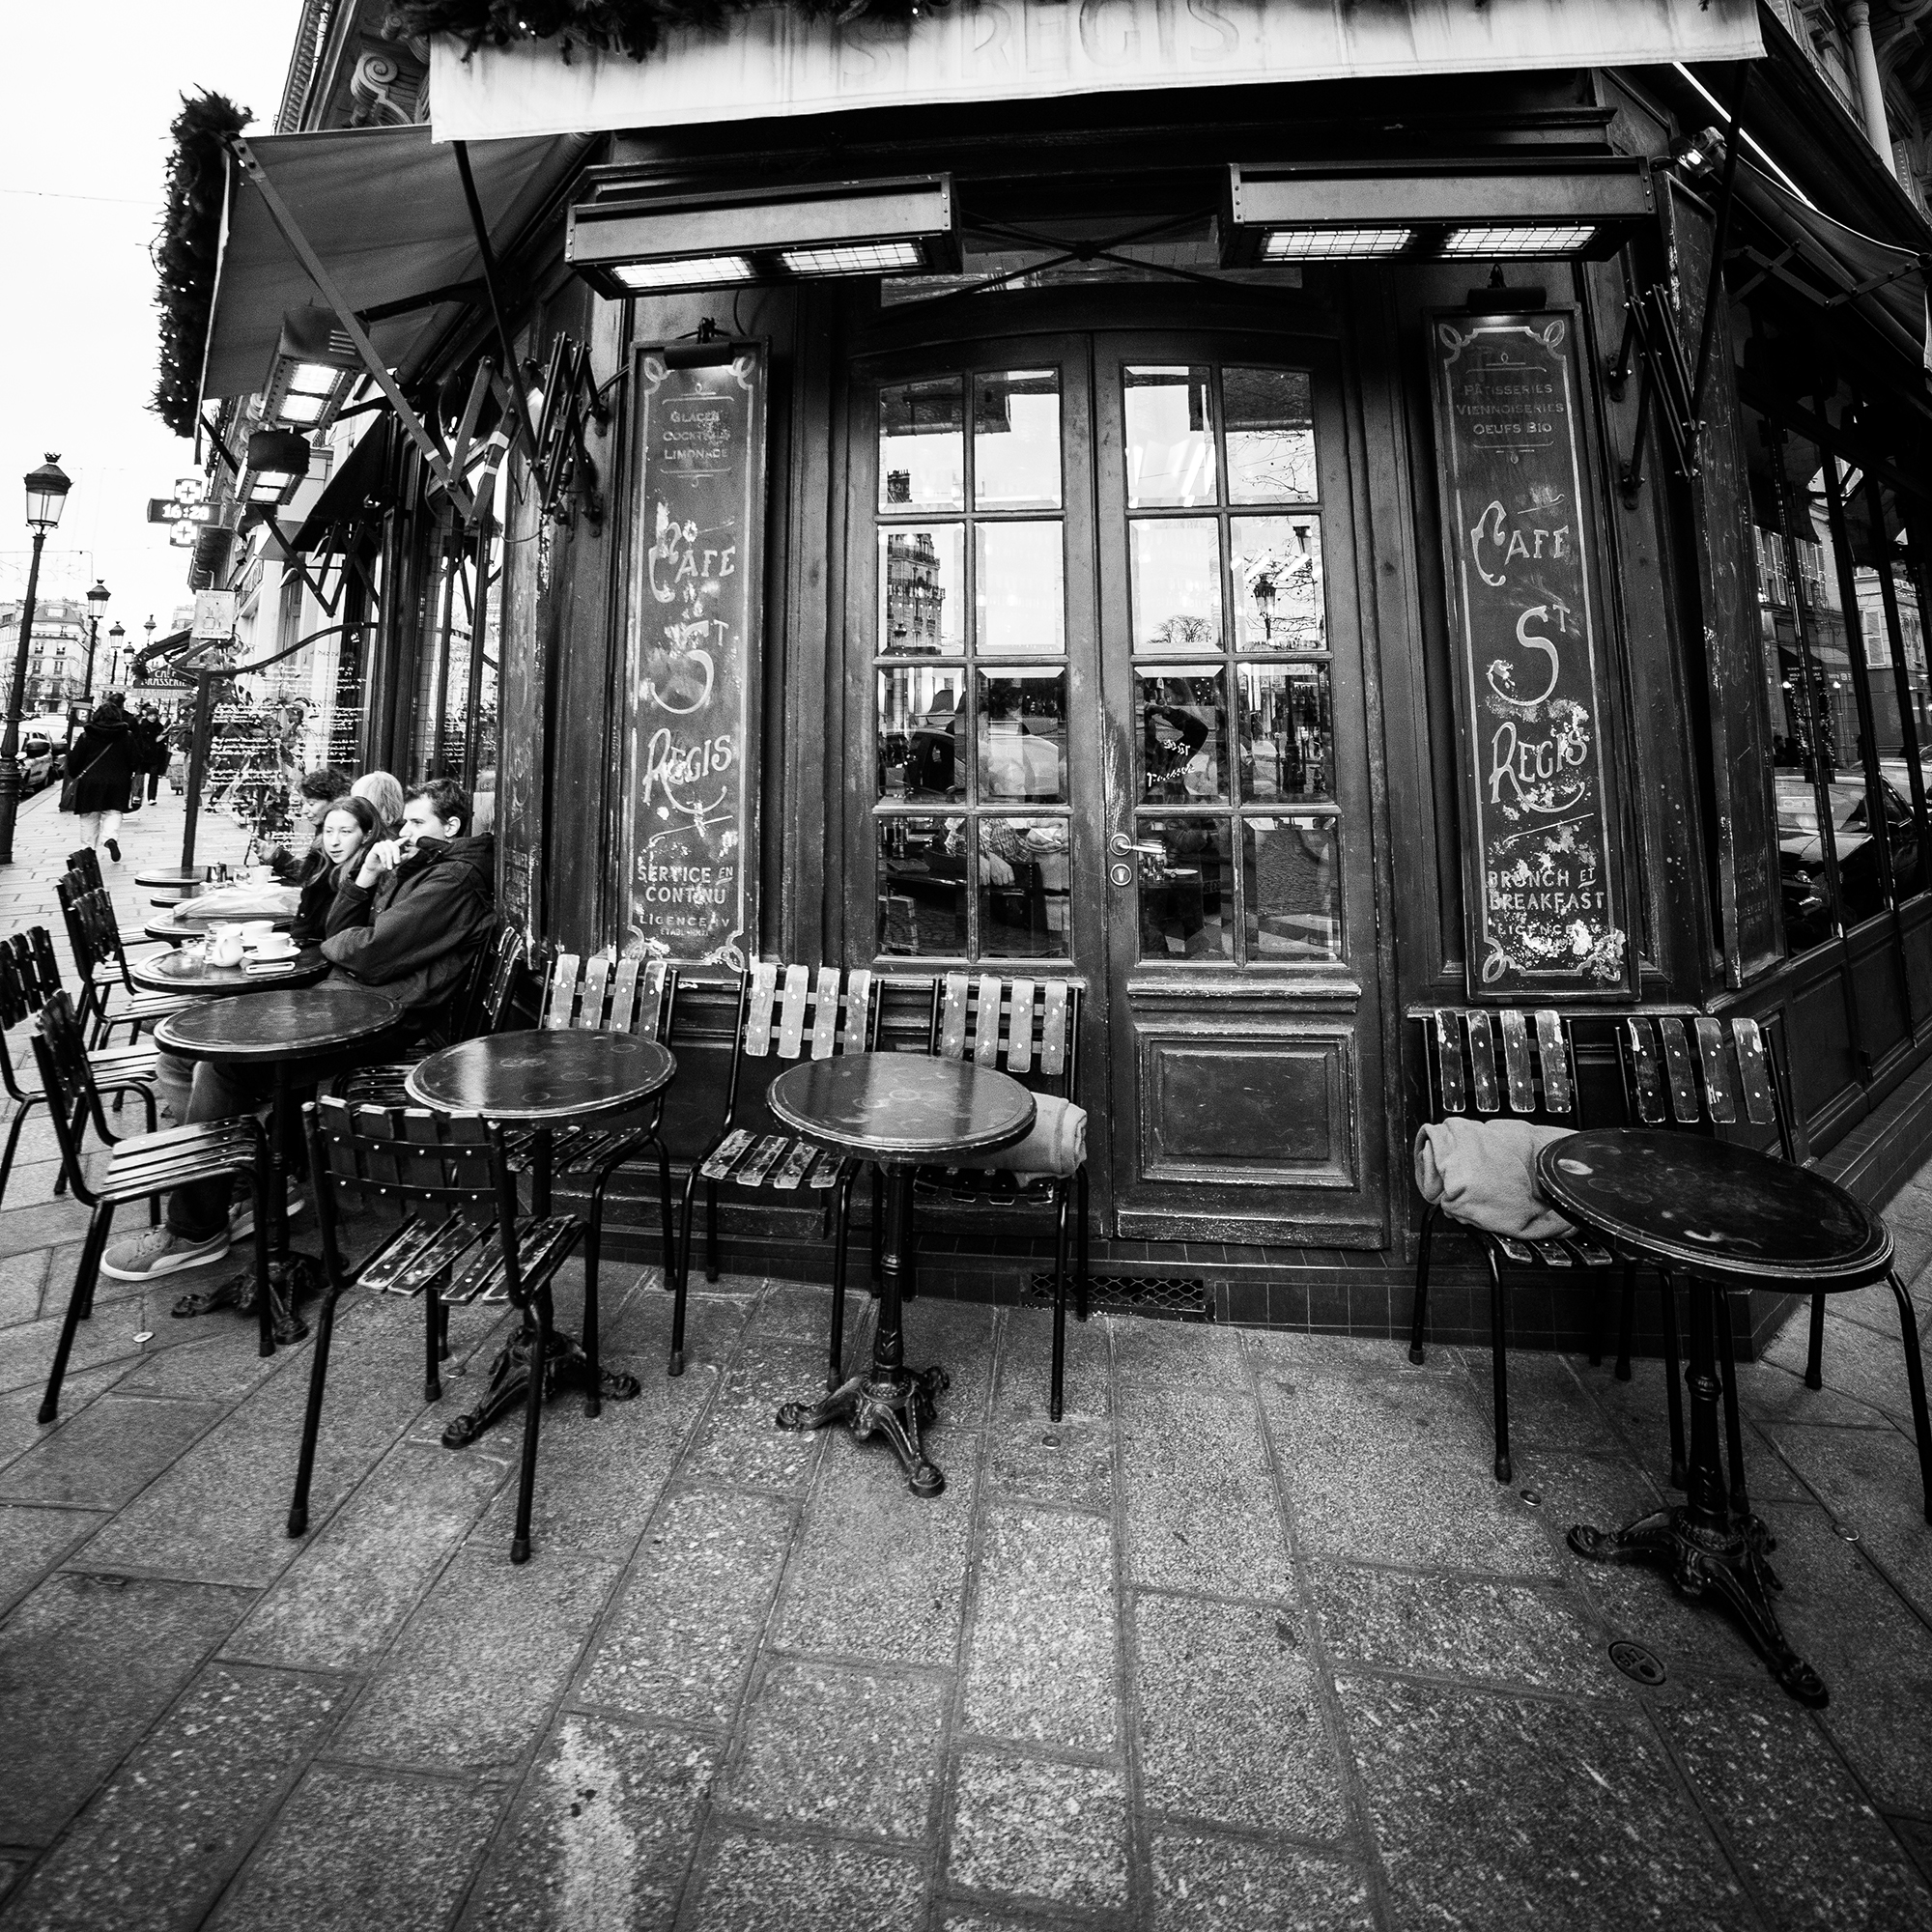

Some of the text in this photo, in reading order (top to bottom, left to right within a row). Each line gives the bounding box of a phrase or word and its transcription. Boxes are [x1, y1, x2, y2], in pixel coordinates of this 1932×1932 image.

[1473, 421, 1552, 435] OEUFS BIO
[664, 448, 729, 460] LIMONADE
[638, 865, 733, 884] SERVICE EN
[1488, 867, 1595, 889] BRUNCH ET
[645, 886, 726, 905] CONTNU
[1490, 892, 1605, 913] BREAKFAST
[639, 913, 707, 927] LICENCE
[1616, 1648, 1645, 1667] GAZ
